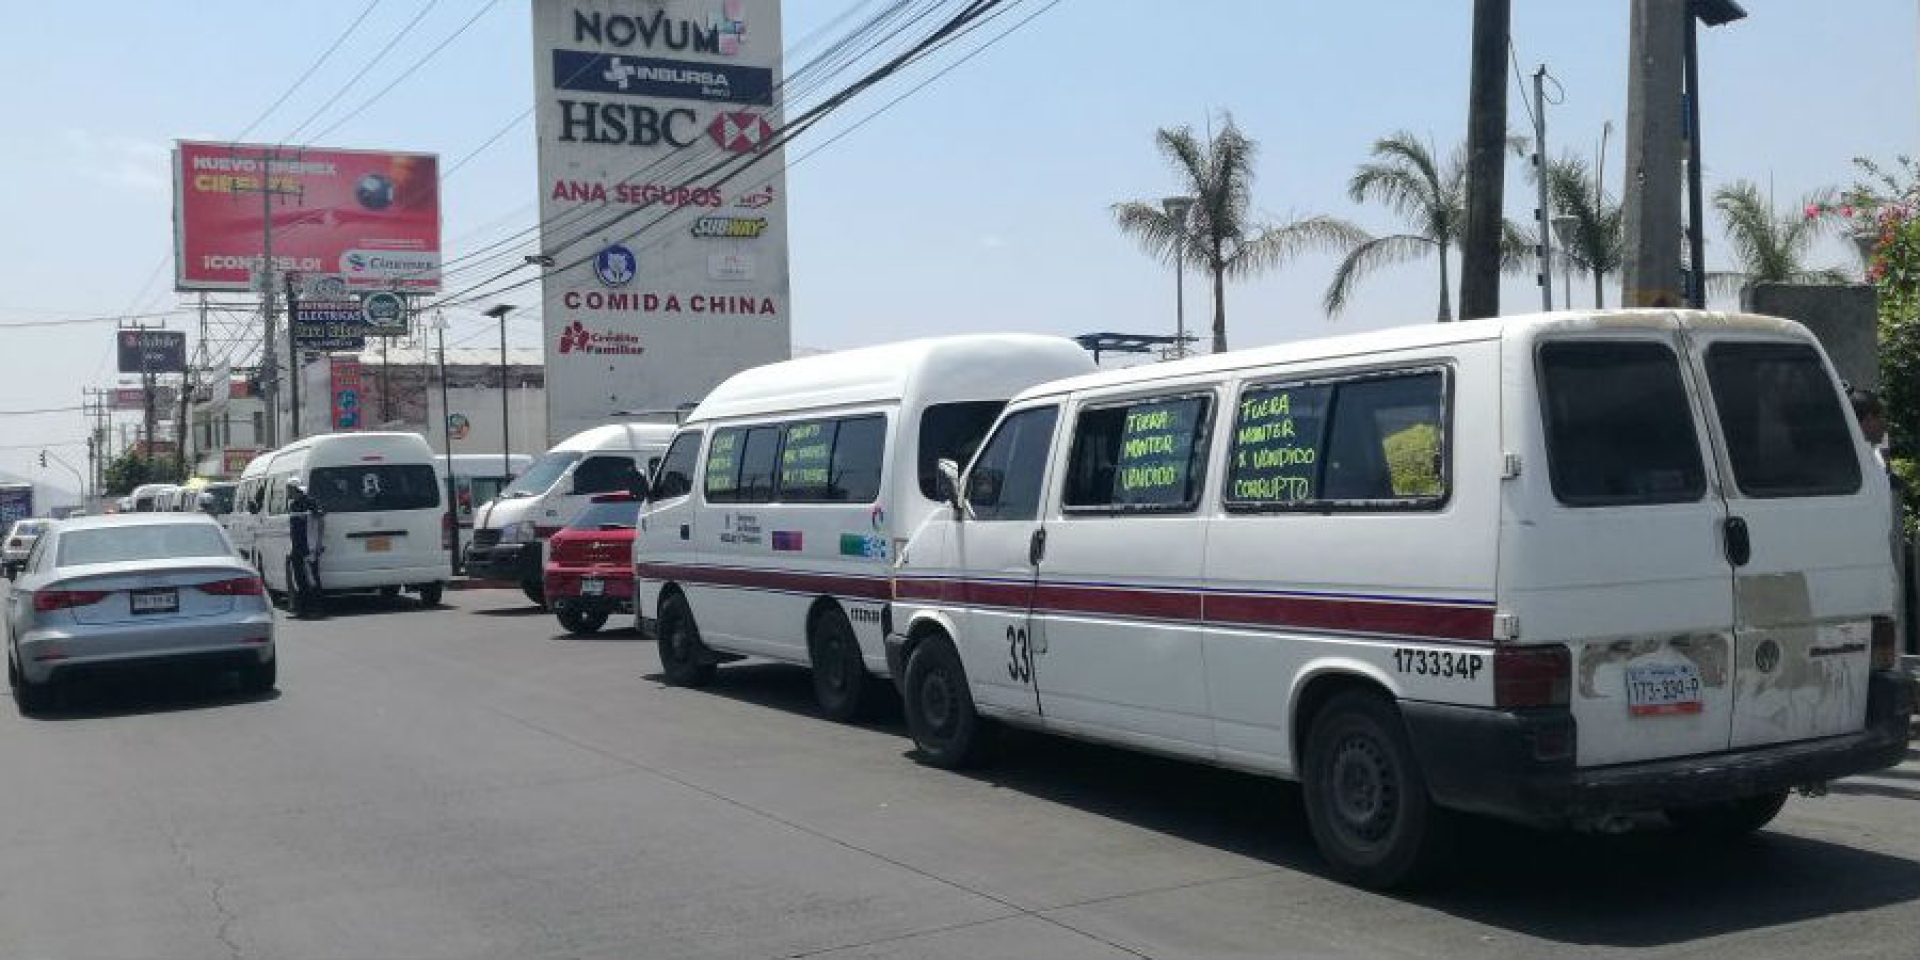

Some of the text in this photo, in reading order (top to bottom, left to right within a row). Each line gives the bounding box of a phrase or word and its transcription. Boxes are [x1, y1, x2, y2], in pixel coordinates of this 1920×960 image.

[574, 9, 720, 53] NOVUM
[637, 67, 729, 86] INBURSA
[558, 100, 698, 148] HSBC
[552, 180, 607, 202] ANA
[615, 183, 722, 209] SEGUROS
[564, 291, 776, 316] COMIDA CHINA
[1241, 394, 1289, 421] FUERA
[1128, 411, 1169, 433] FUERA
[1234, 475, 1310, 500] CORRUPTO
[1007, 625, 1029, 683] 33
[1394, 648, 1483, 679] 173334P
